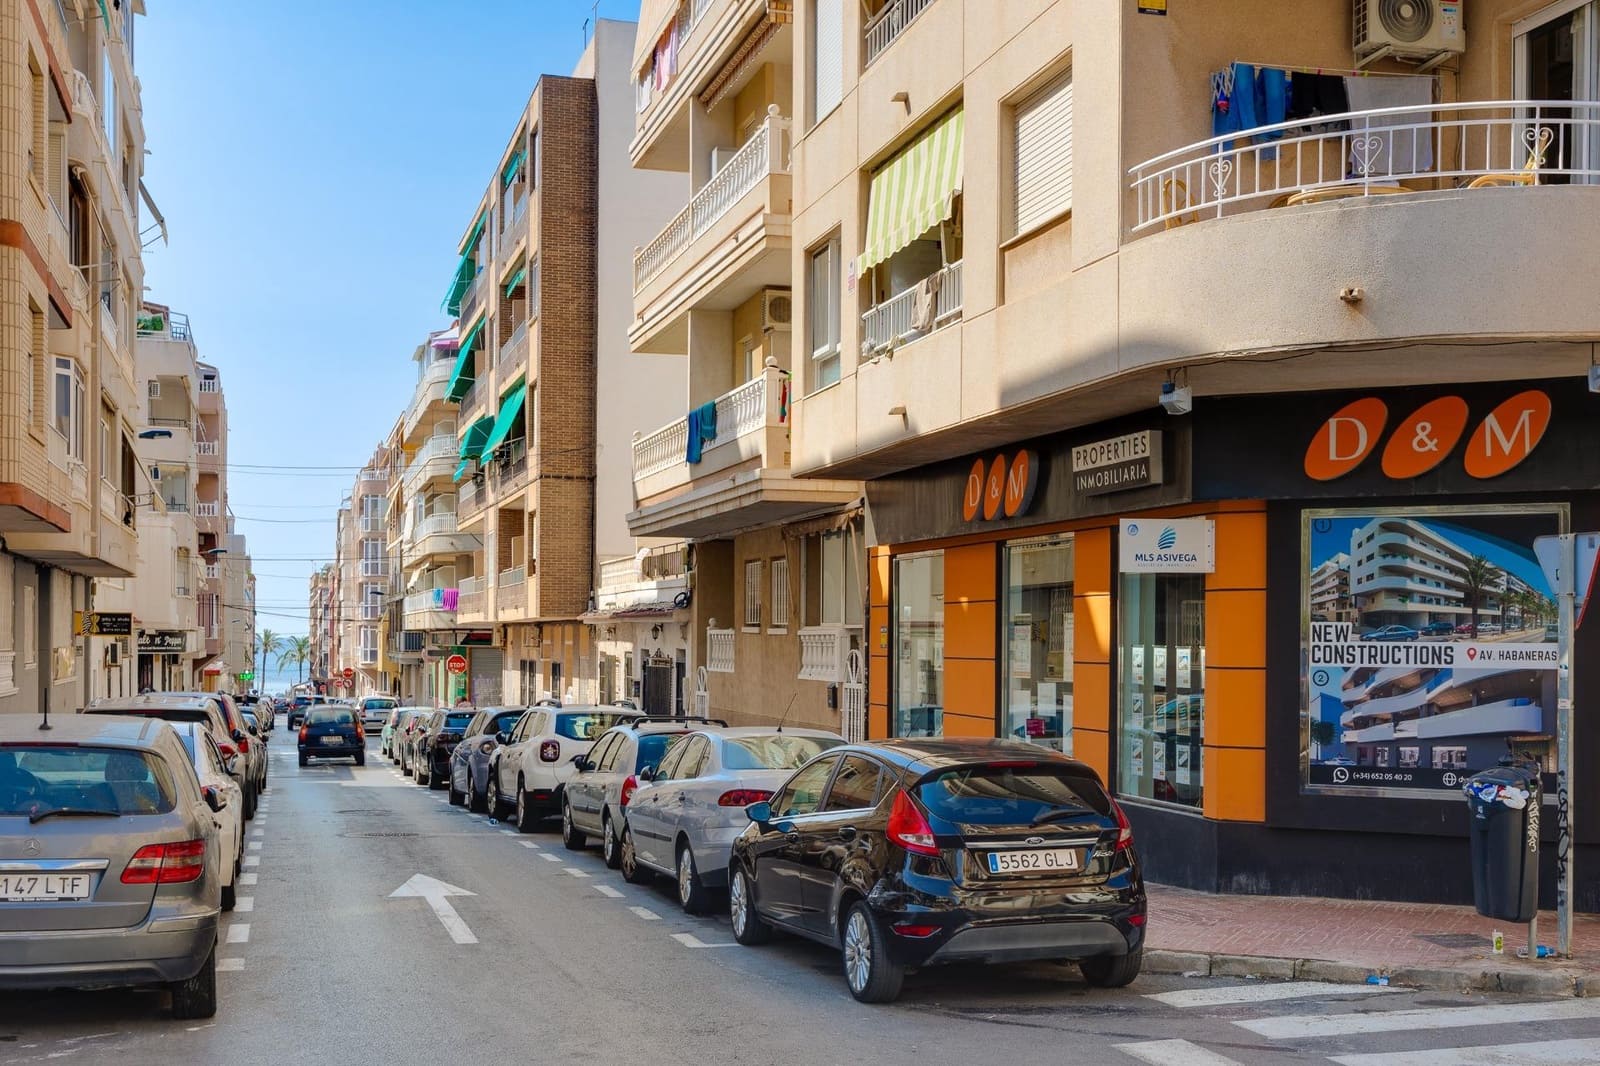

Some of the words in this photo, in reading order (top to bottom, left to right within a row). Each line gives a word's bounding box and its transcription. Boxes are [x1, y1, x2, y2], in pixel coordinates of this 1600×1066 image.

[1328, 417, 1368, 461] D
[1412, 421, 1438, 452] &
[1485, 409, 1535, 457] M
[1076, 435, 1147, 468] PROPERTIES
[969, 473, 980, 507] D
[991, 475, 999, 499] &
[1009, 464, 1024, 501] M
[1076, 463, 1147, 491] INMOBILIARIA
[1135, 553, 1154, 562] MLS
[1156, 553, 1197, 562] ASIVEGA
[1311, 624, 1350, 642] NEW
[1311, 644, 1454, 665] CONSTRUCTIONS
[1479, 649, 1496, 661] AV.
[1498, 650, 1558, 662] HABANERAS
[1352, 771, 1370, 780] (+34)
[1371, 772, 1384, 780] 652
[999, 853, 1041, 870] 5562
[1044, 851, 1074, 868] GLJ
[0, 877, 38, 895] 147
[45, 877, 82, 894] LTF
